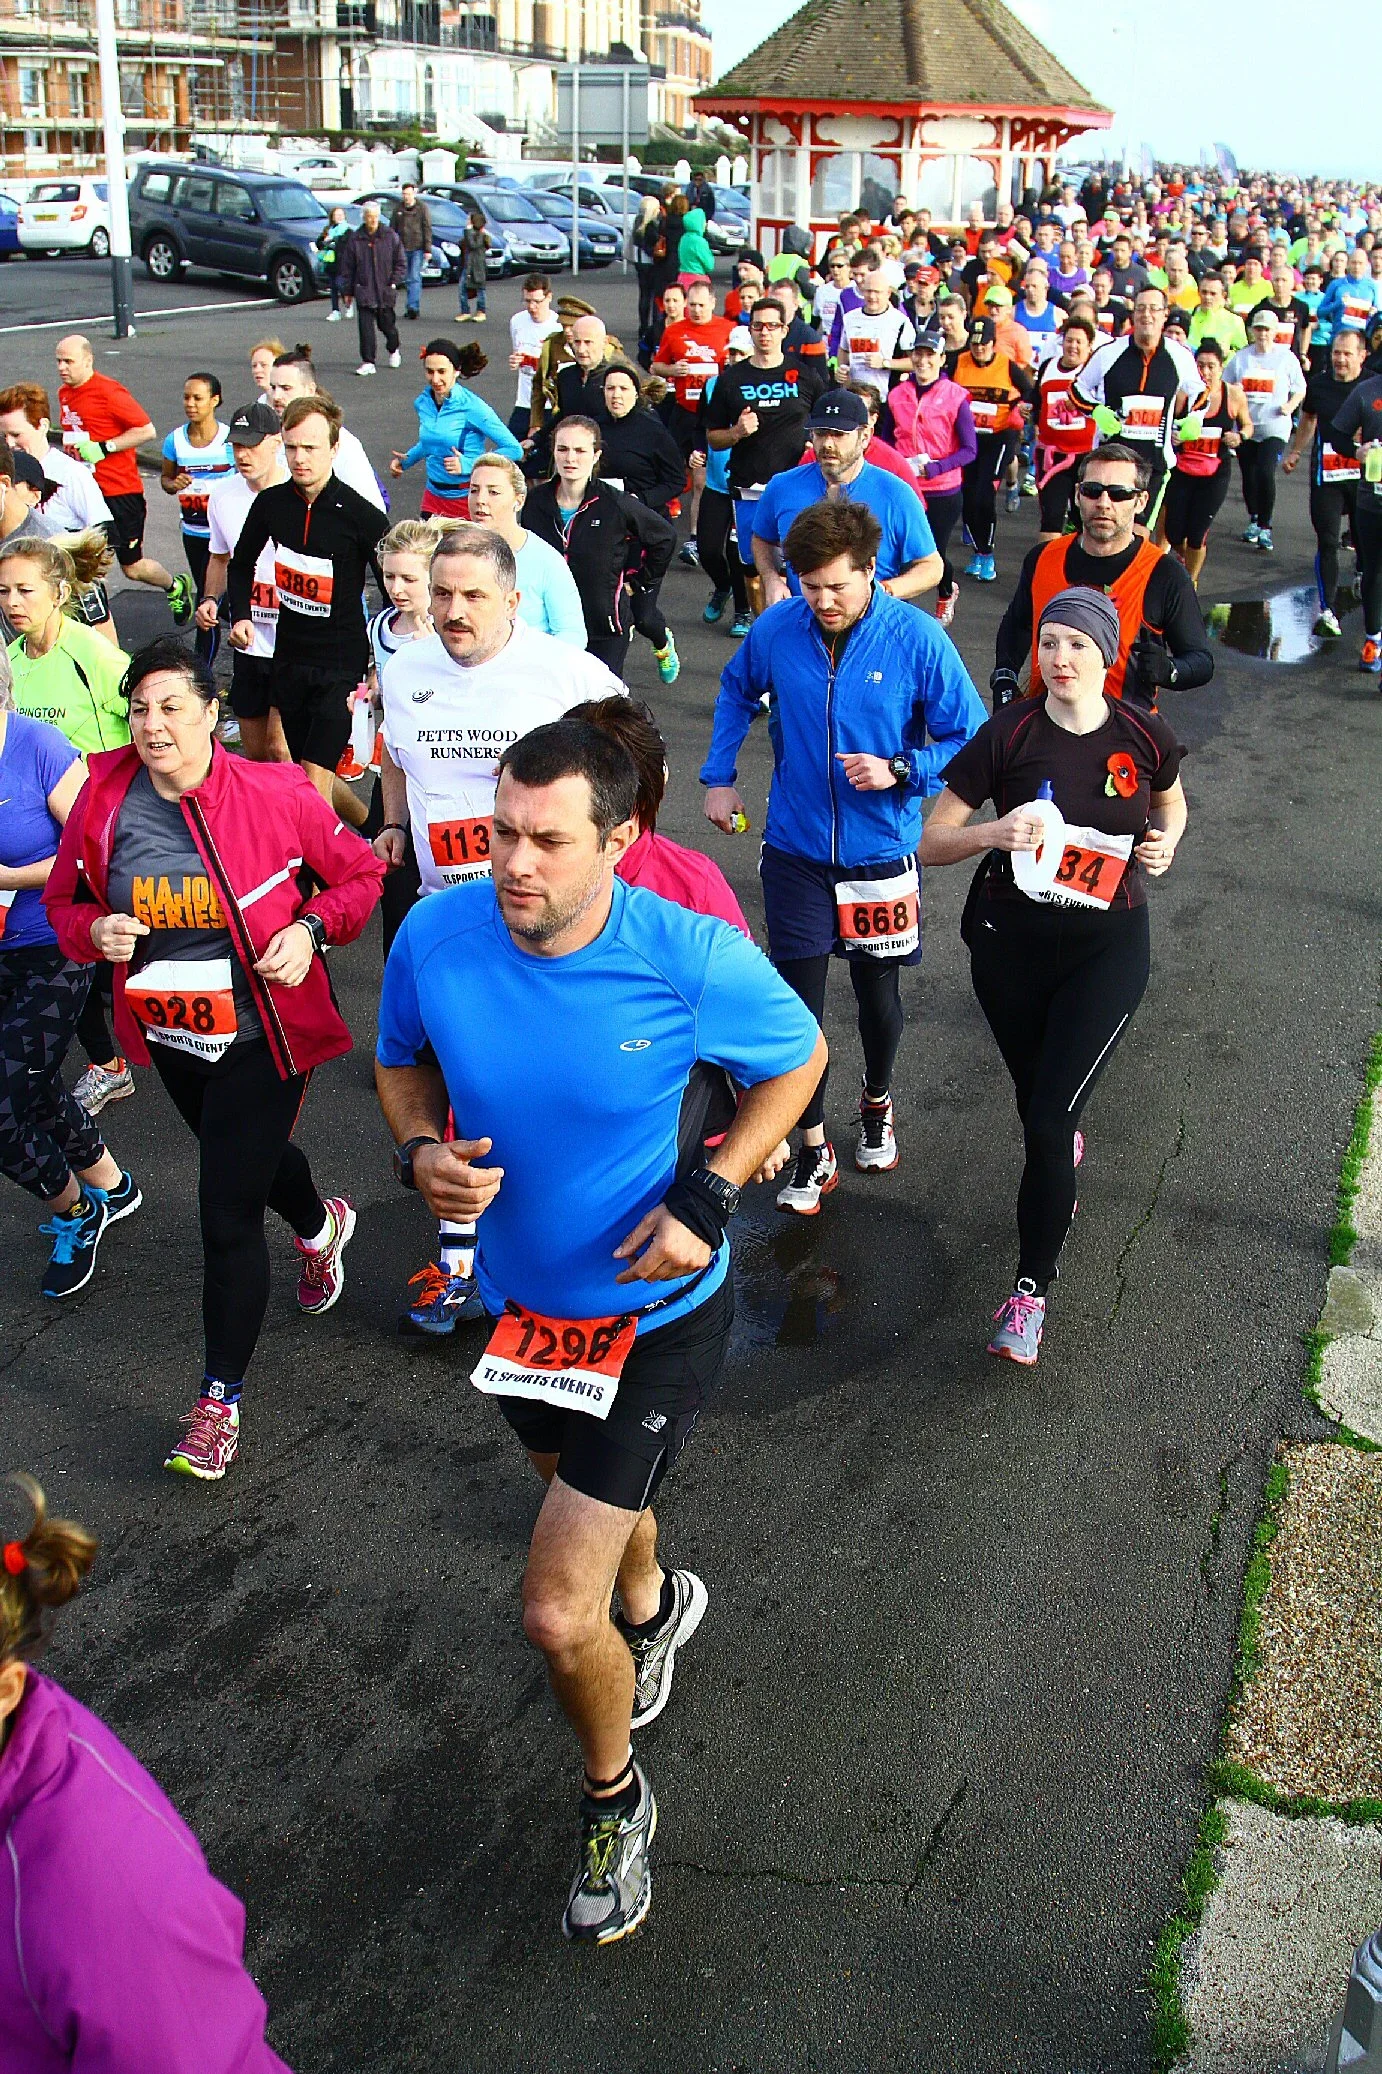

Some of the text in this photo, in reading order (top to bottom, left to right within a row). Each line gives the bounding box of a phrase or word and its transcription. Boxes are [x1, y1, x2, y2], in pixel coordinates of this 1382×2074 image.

[740, 382, 799, 400] BOSH
[281, 569, 319, 599] 389
[417, 729, 518, 743] PETTS WOOD
[430, 747, 501, 760] RUNNERS
[853, 901, 909, 936] 668
[857, 941, 890, 952] SPORTS
[145, 996, 216, 1034] 928
[159, 1031, 193, 1049] SPORTS
[194, 1038, 230, 1054] EVENTS
[515, 1317, 616, 1367] 1296
[483, 1367, 605, 1402] TL SPORTS EVENTS
